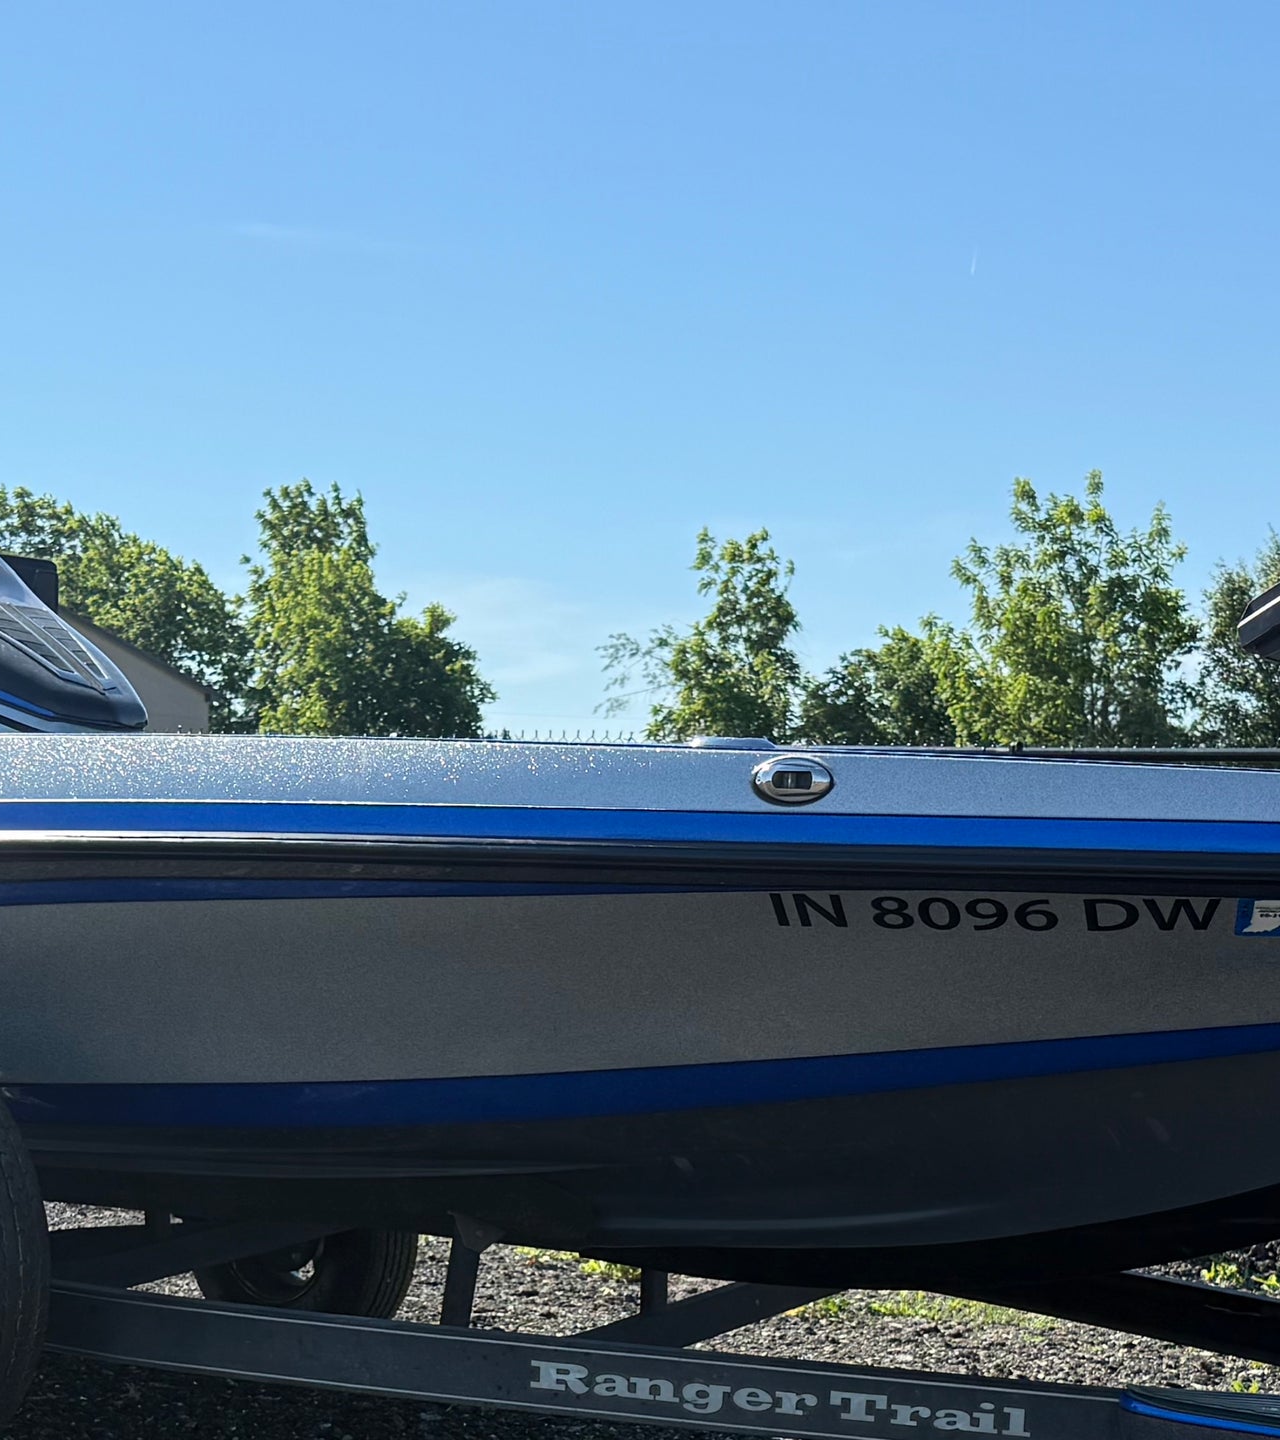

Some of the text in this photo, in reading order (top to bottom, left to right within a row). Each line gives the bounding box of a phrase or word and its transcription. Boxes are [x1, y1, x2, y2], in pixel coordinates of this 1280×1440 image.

[769, 893, 1222, 932] IN 8096 DW
[530, 1359, 1031, 1438] Ranger Trail
